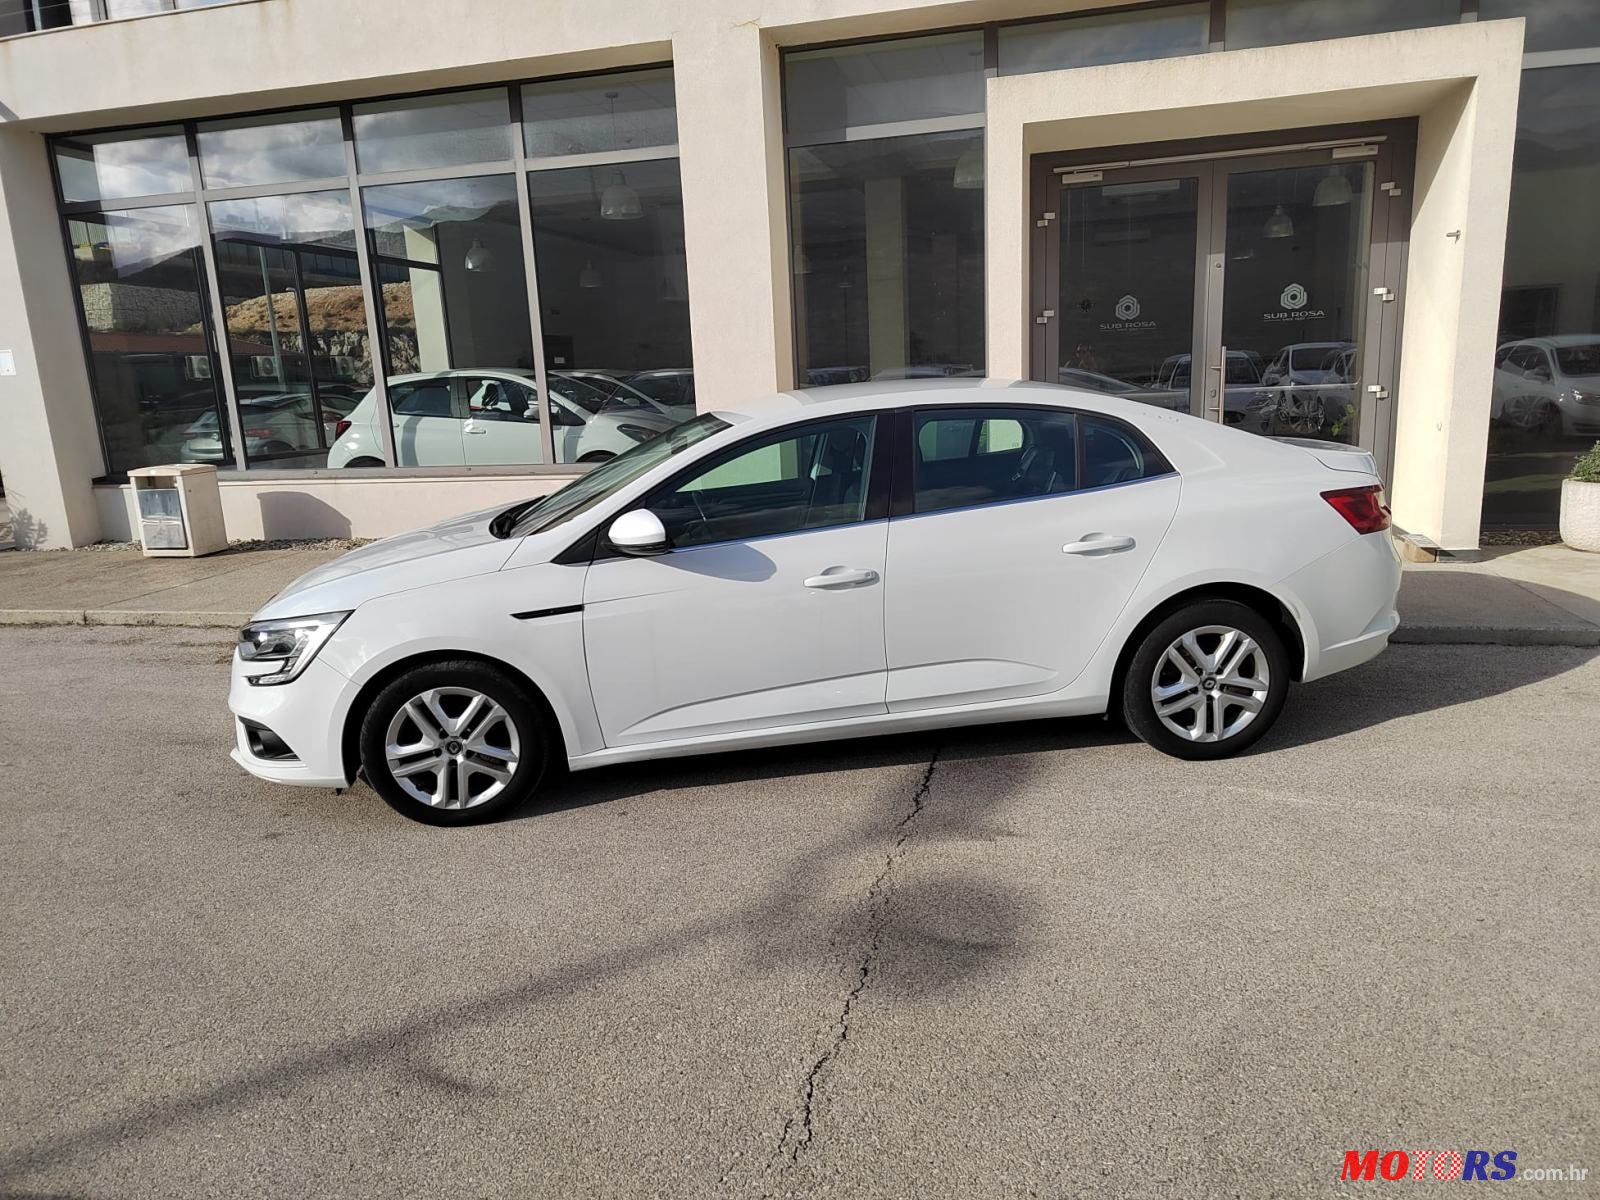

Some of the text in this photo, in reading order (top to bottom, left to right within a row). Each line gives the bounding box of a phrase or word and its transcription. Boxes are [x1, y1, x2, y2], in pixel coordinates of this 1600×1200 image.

[1263, 312, 1288, 320] SUB
[1291, 310, 1325, 318] ROSA
[1099, 322, 1122, 330] SUB
[1125, 320, 1157, 328] ROSA
